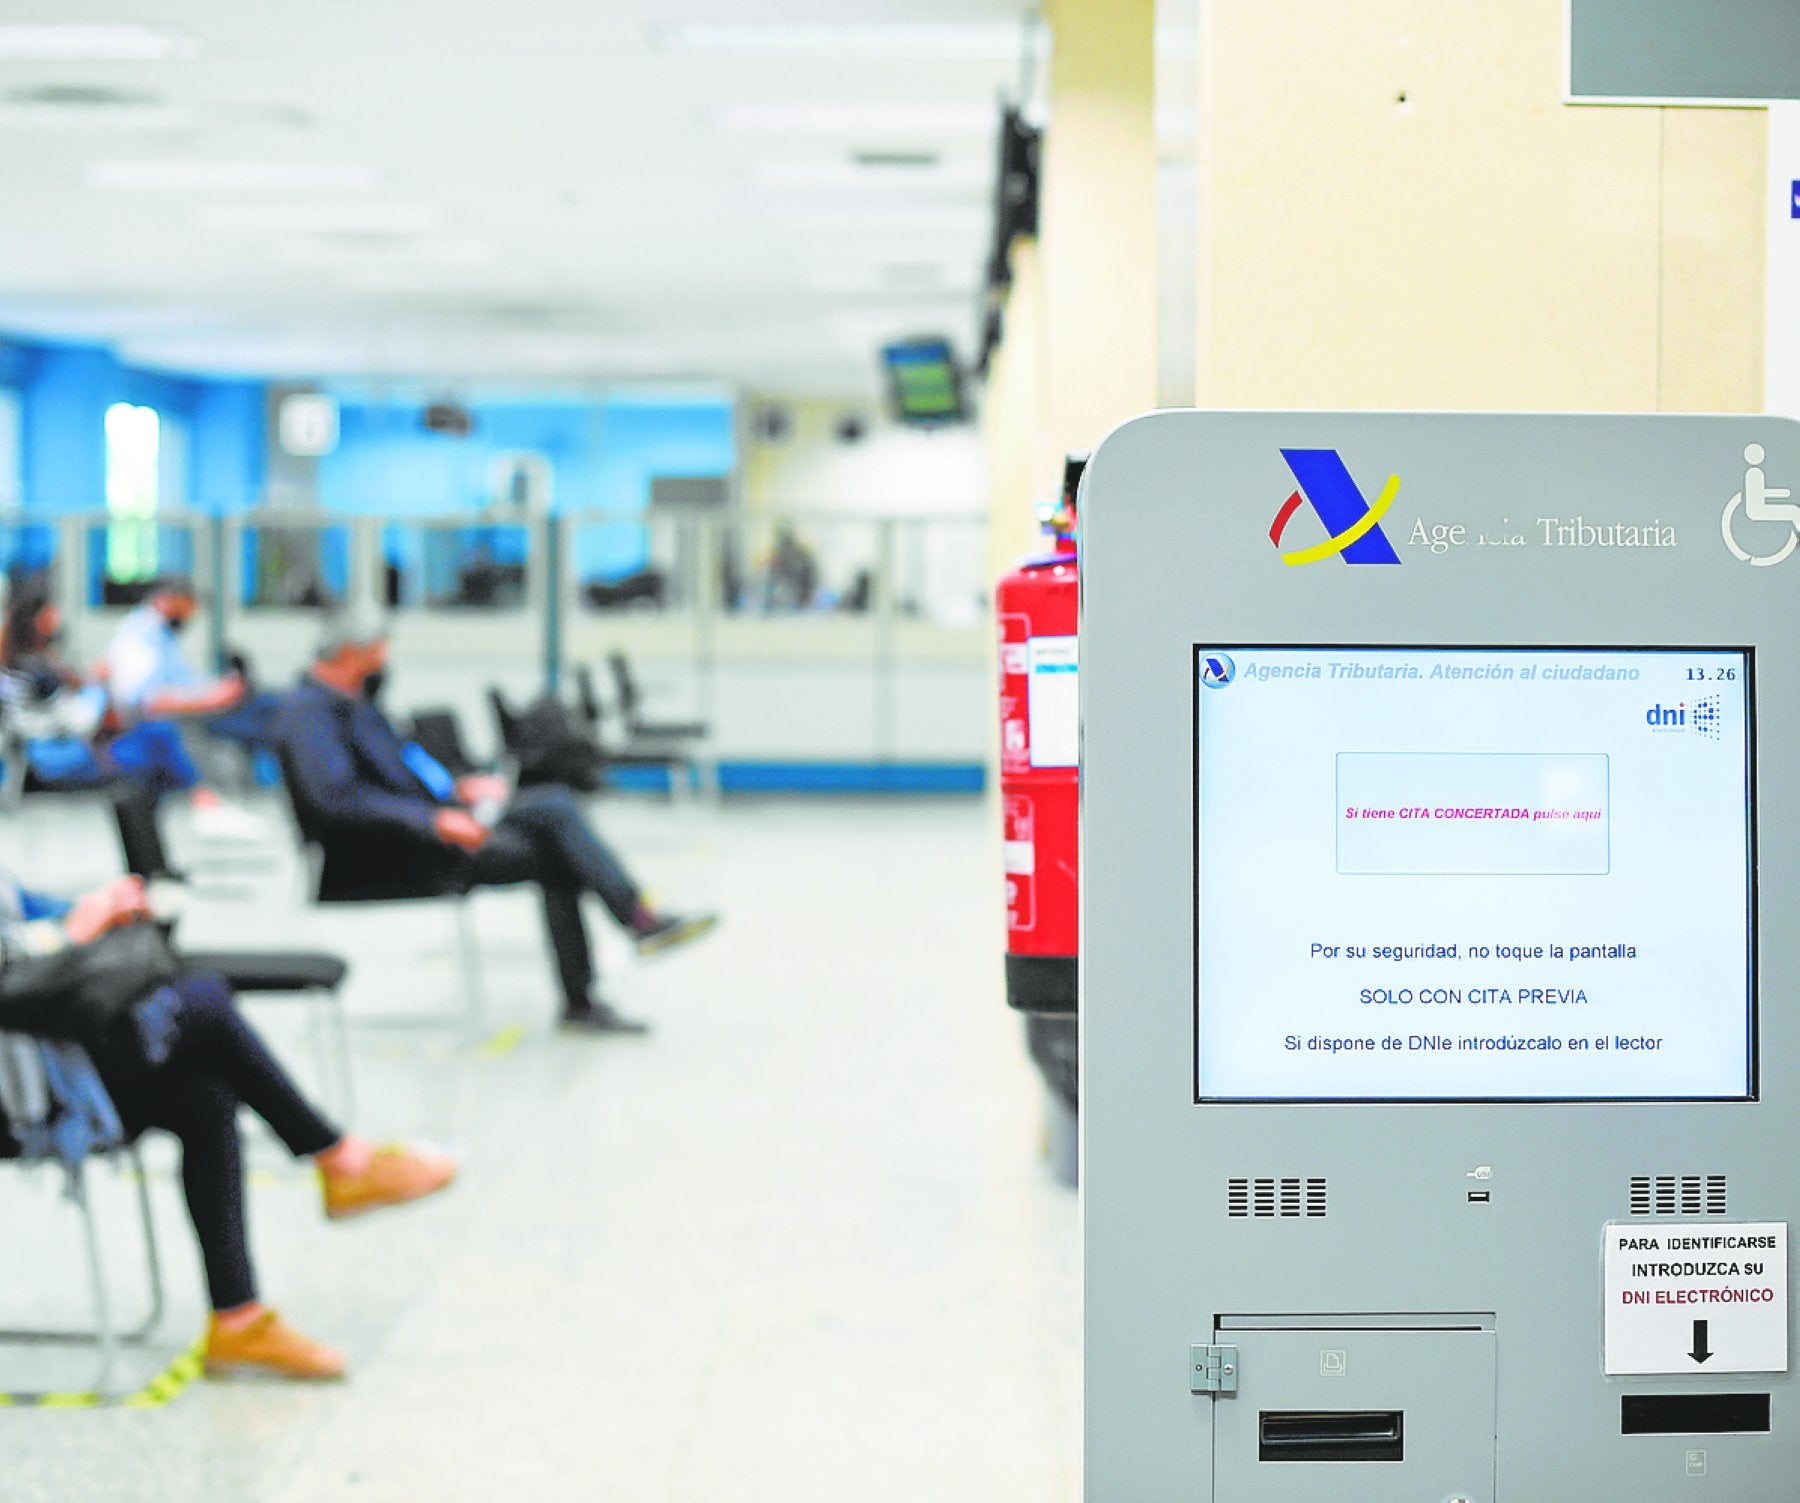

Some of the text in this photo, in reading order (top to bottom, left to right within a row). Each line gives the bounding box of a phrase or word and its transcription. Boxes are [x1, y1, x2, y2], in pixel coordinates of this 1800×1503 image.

[1536, 516, 1677, 547] Tributaria
[1243, 662, 1640, 683] Agencia Tributaria. Atención al ciudadano
[1686, 667, 1736, 681] 13.26
[1646, 702, 1686, 725] dni
[1345, 806, 1359, 819] Si
[1361, 807, 1396, 819] tiene
[1398, 807, 1431, 819] CITA
[1434, 807, 1530, 819] CONCERTADA
[1310, 942, 1638, 962] Por su seguridad, no toque la pantalla
[1359, 988, 1588, 1005] SOLO CON CITA PREVIA
[1283, 1034, 1663, 1055] Si dispone de DNIe introdúzcalo en el lector
[1619, 1236, 1777, 1251] PARA IDENTIFICARSE
[1632, 1262, 1764, 1278] INTRODUZCA SU
[1622, 1285, 1775, 1305] DNI ELECTRÓNICO
